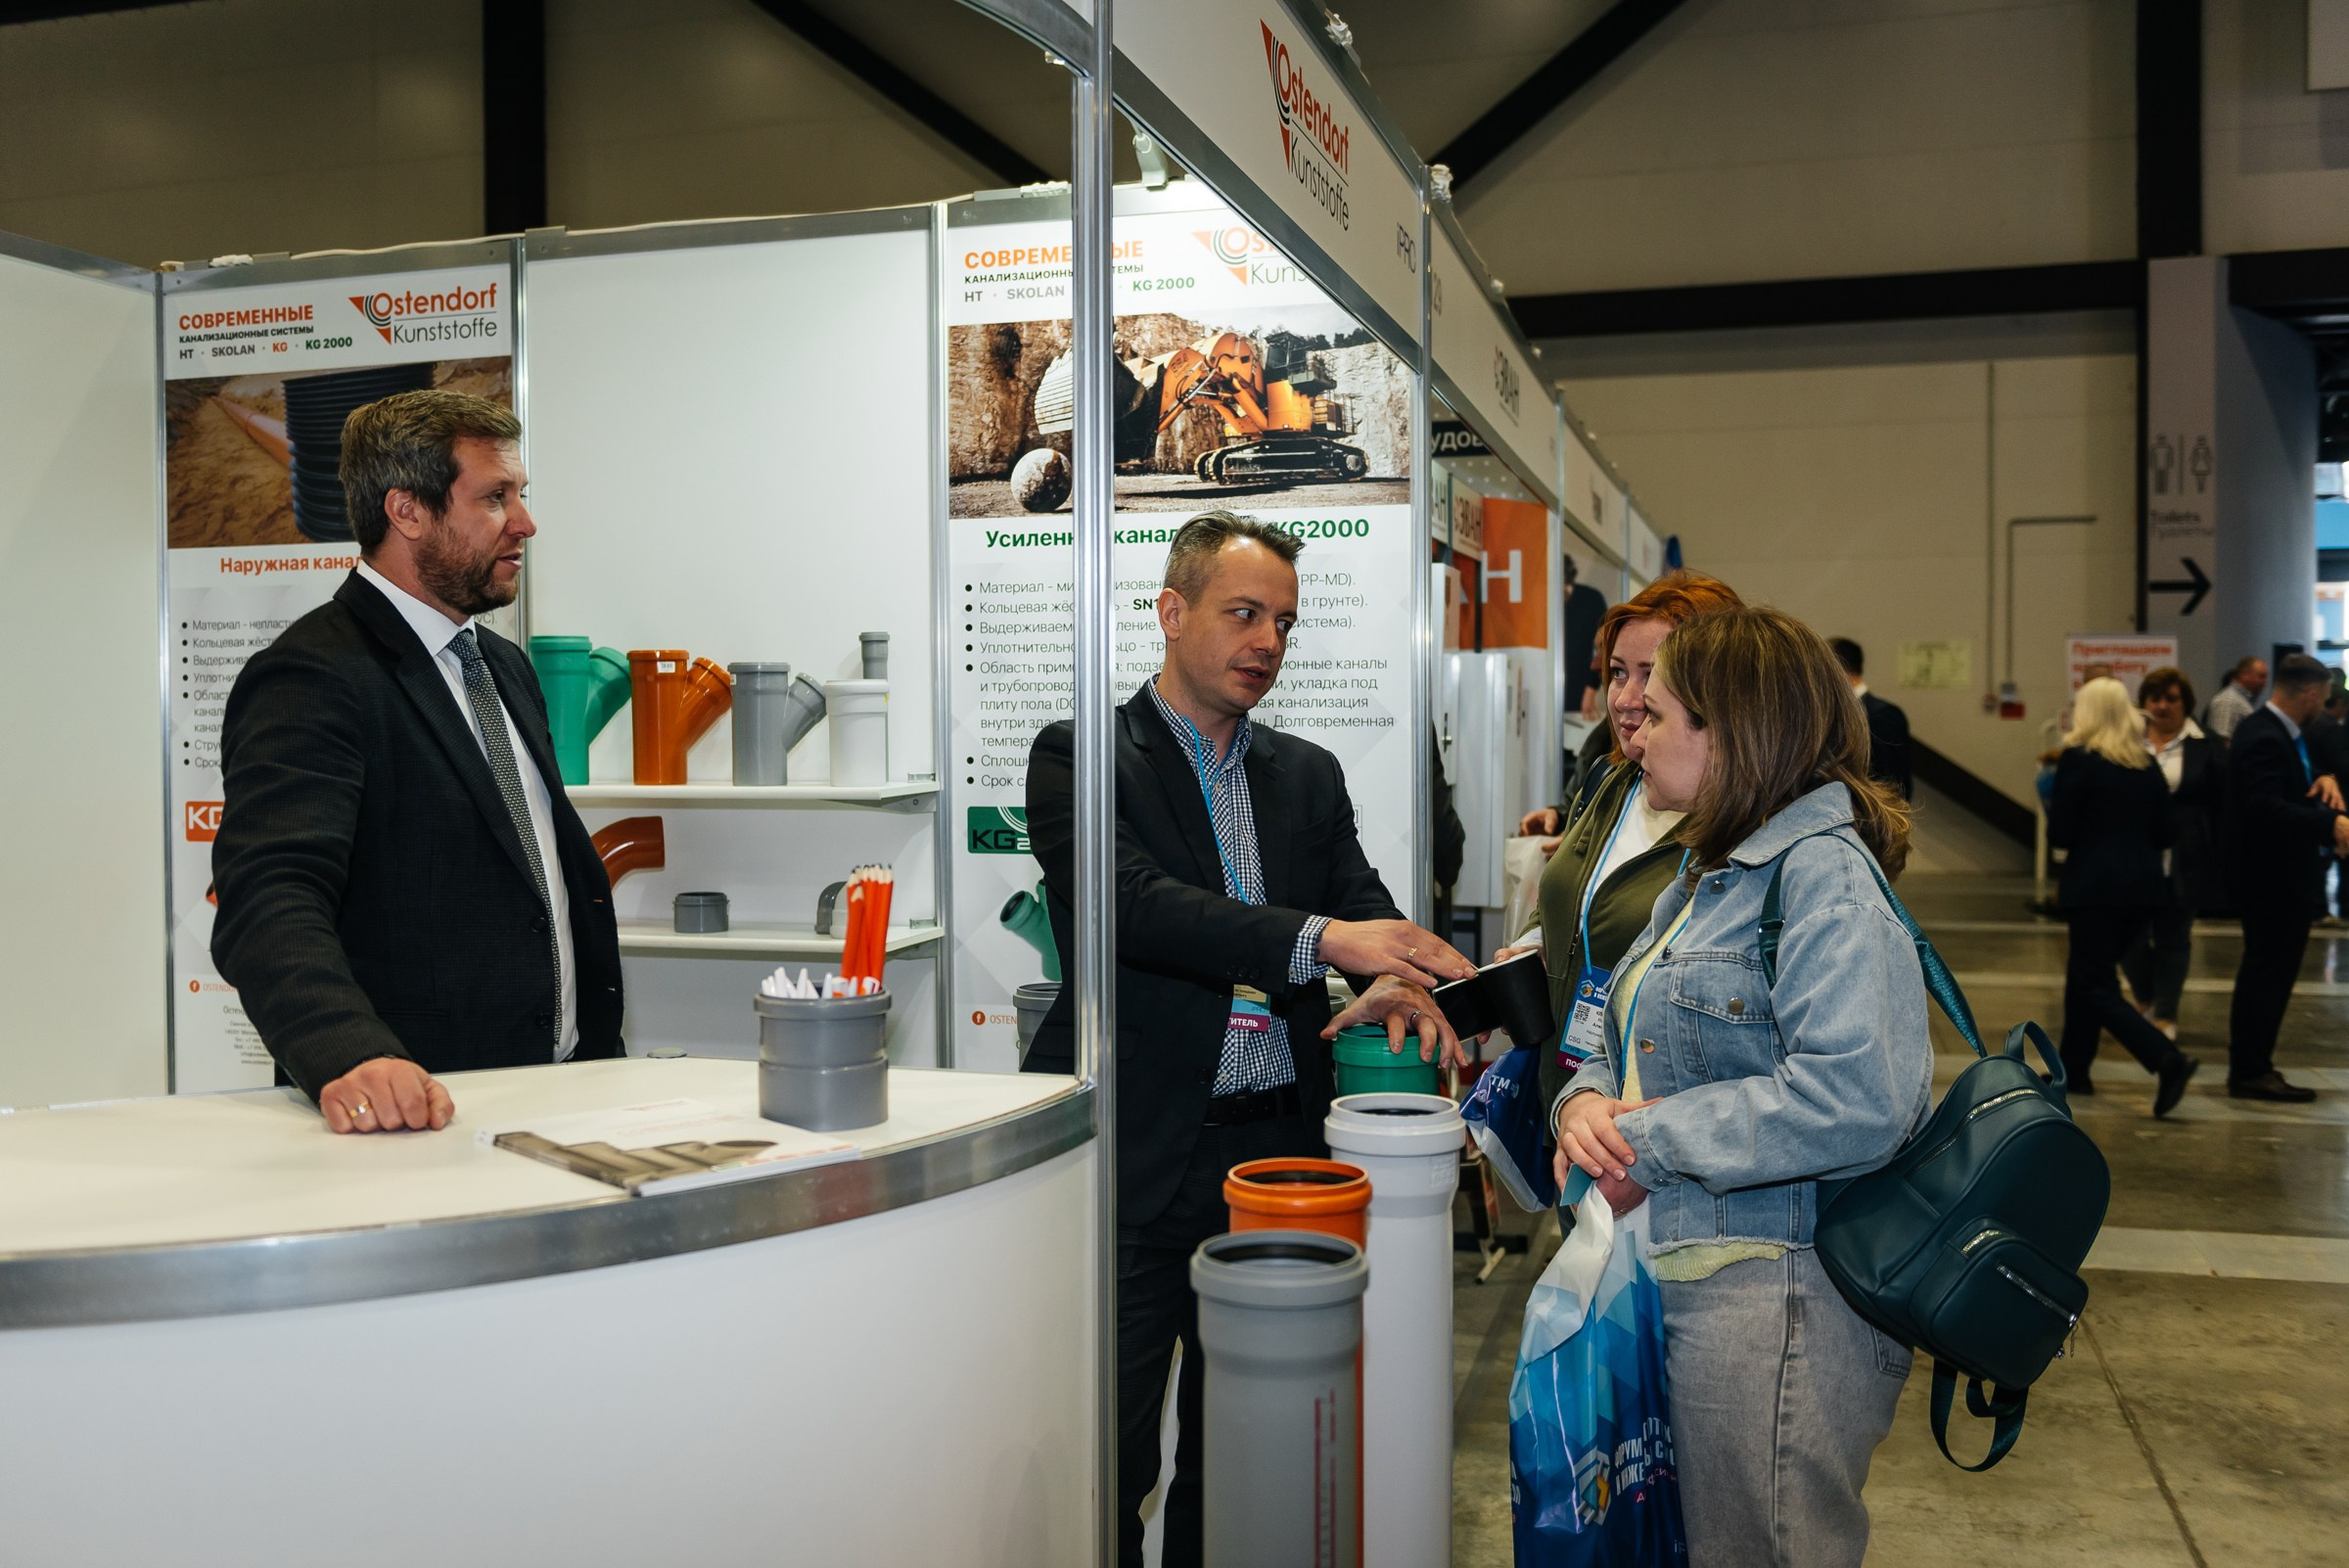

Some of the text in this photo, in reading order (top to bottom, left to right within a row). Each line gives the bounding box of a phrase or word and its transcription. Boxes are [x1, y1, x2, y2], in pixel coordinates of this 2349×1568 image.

[1277, 43, 1349, 175] Ostendorf
[1290, 131, 1349, 231] Kunststoffe
[1007, 286, 1065, 300] SKOLAN
[1132, 280, 1153, 292] KG
[1156, 277, 1196, 292] 2000
[373, 283, 497, 317] Ostendorf
[179, 304, 313, 331] СОВРЕМЕННЫЕ
[179, 326, 314, 344] КАНАЛИЗАЦИОННЫЕ СИСТЕМЫ
[393, 317, 497, 345] Kunststoffe
[211, 345, 255, 357] SKOLAN
[272, 342, 288, 352] KG
[305, 340, 321, 350] KG
[324, 337, 353, 349] 2000
[220, 557, 309, 576] Наружная
[980, 581, 1044, 596] Материал
[980, 601, 1047, 616] Кольцевая
[1302, 597, 1309, 608] в
[1313, 594, 1368, 609] грунте).
[193, 621, 241, 632] Материал
[980, 622, 1074, 636] Выдерживаем
[1116, 621, 1157, 631] ление
[193, 637, 245, 649] Кольцевая
[981, 661, 1035, 674] Область
[1336, 659, 1388, 669] каналы
[981, 681, 989, 691] и
[1290, 679, 1348, 691] укладка
[1352, 678, 1379, 690] под
[981, 700, 1018, 713] плиту
[1021, 699, 1052, 711] пола
[1277, 698, 1368, 710] канализация
[981, 718, 1026, 730] внутри
[1272, 715, 1394, 730] Долговременная
[195, 757, 219, 770] Срок
[982, 774, 1014, 790] Срок
[973, 829, 1031, 851] KG2
[990, 1014, 1018, 1025] OSTEN
[1568, 1035, 1582, 1044] CSG
[1565, 1058, 1582, 1070] ПОС
